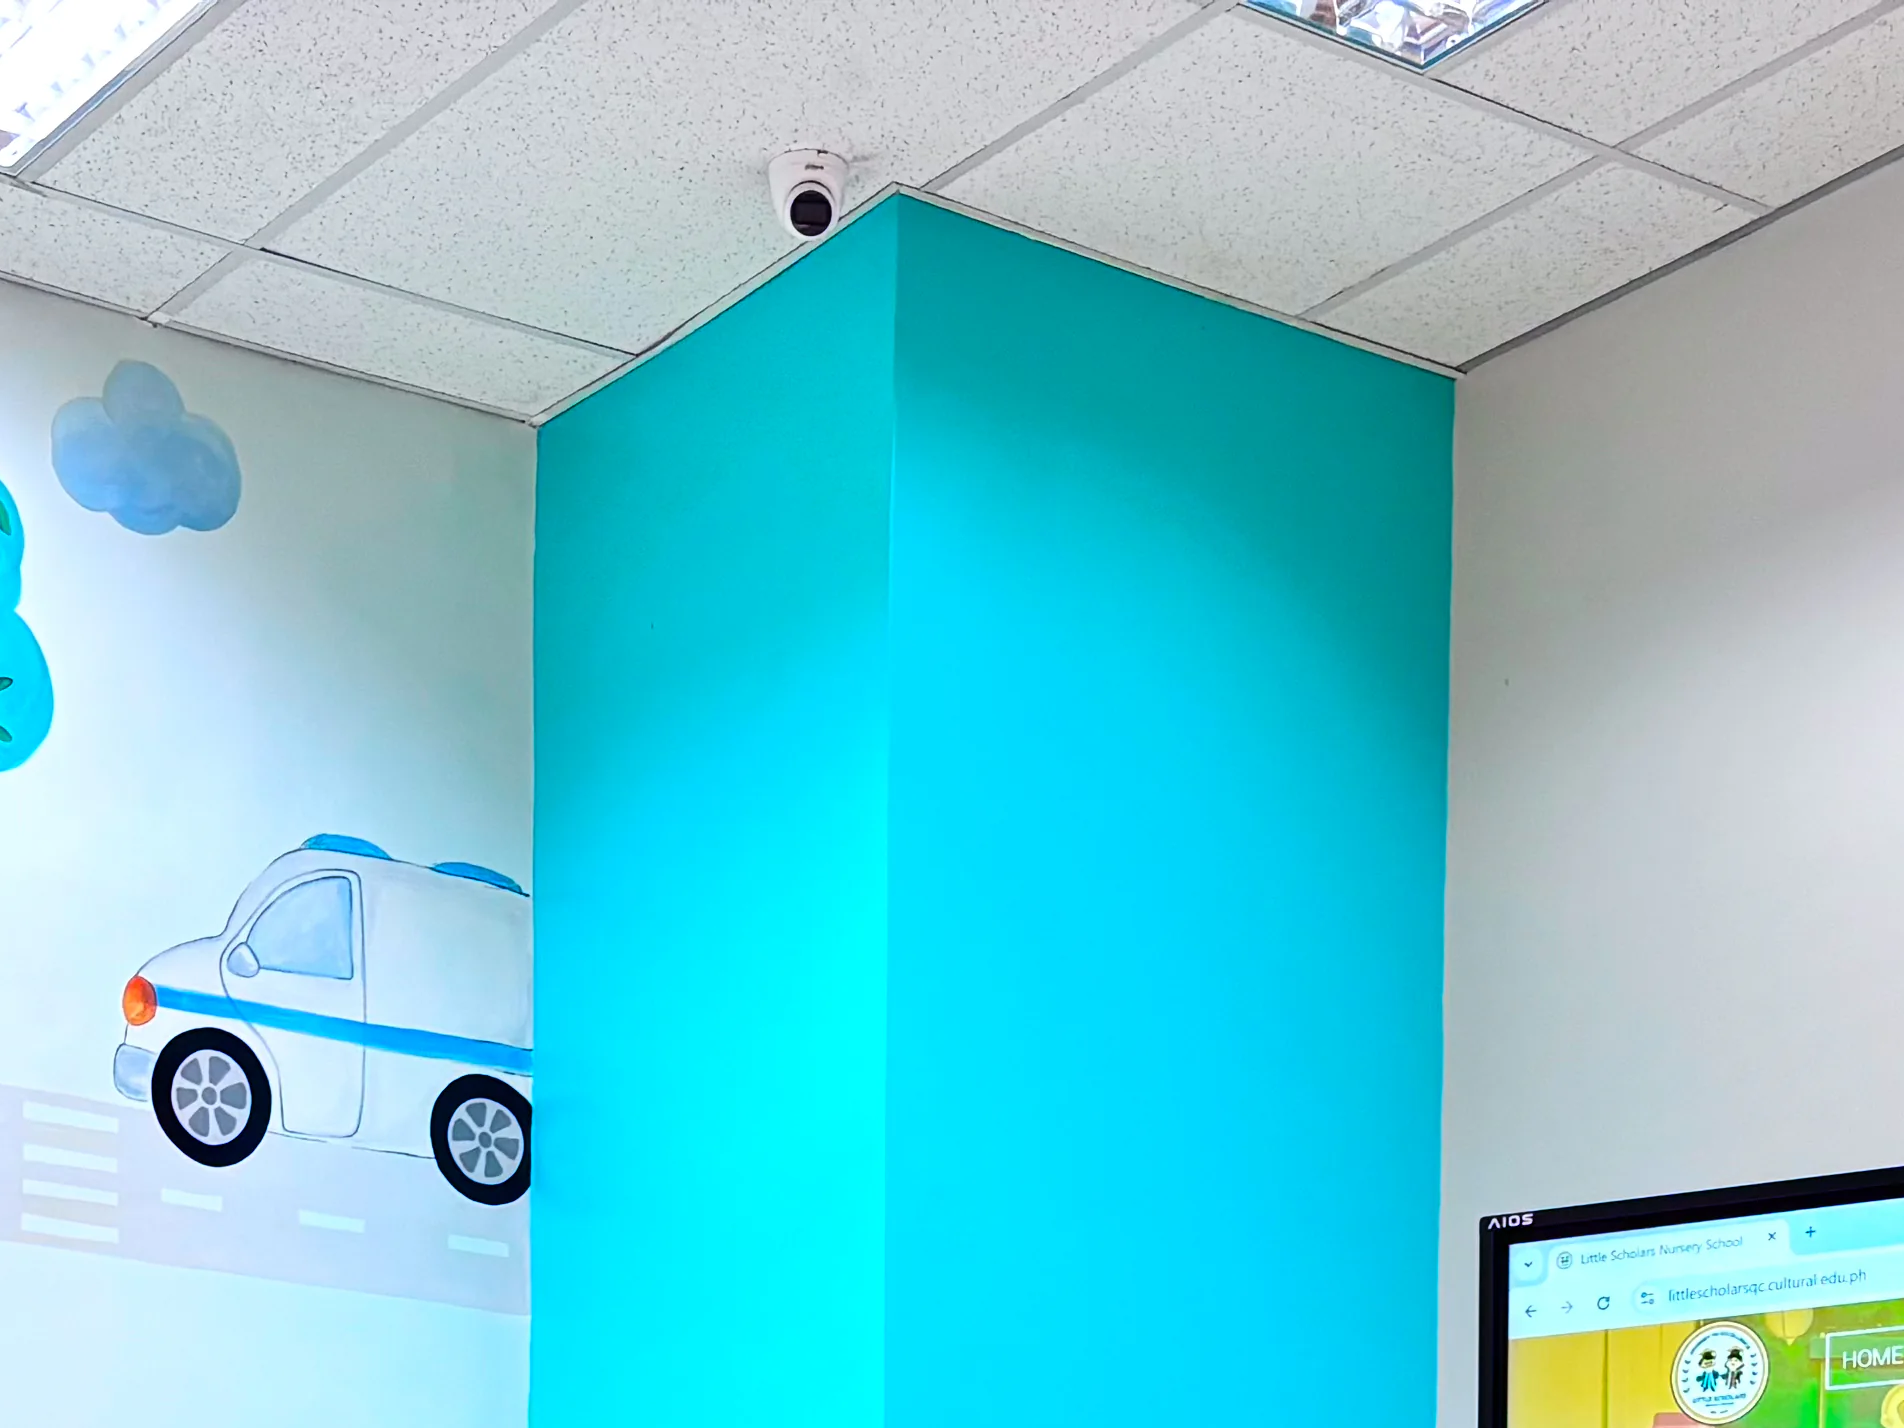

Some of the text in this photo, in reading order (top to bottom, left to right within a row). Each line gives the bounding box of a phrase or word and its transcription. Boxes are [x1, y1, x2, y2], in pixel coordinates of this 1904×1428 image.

[1581, 1236, 1743, 1265] Little Scholars Nursery School
[1842, 1345, 1904, 1370] HOME
